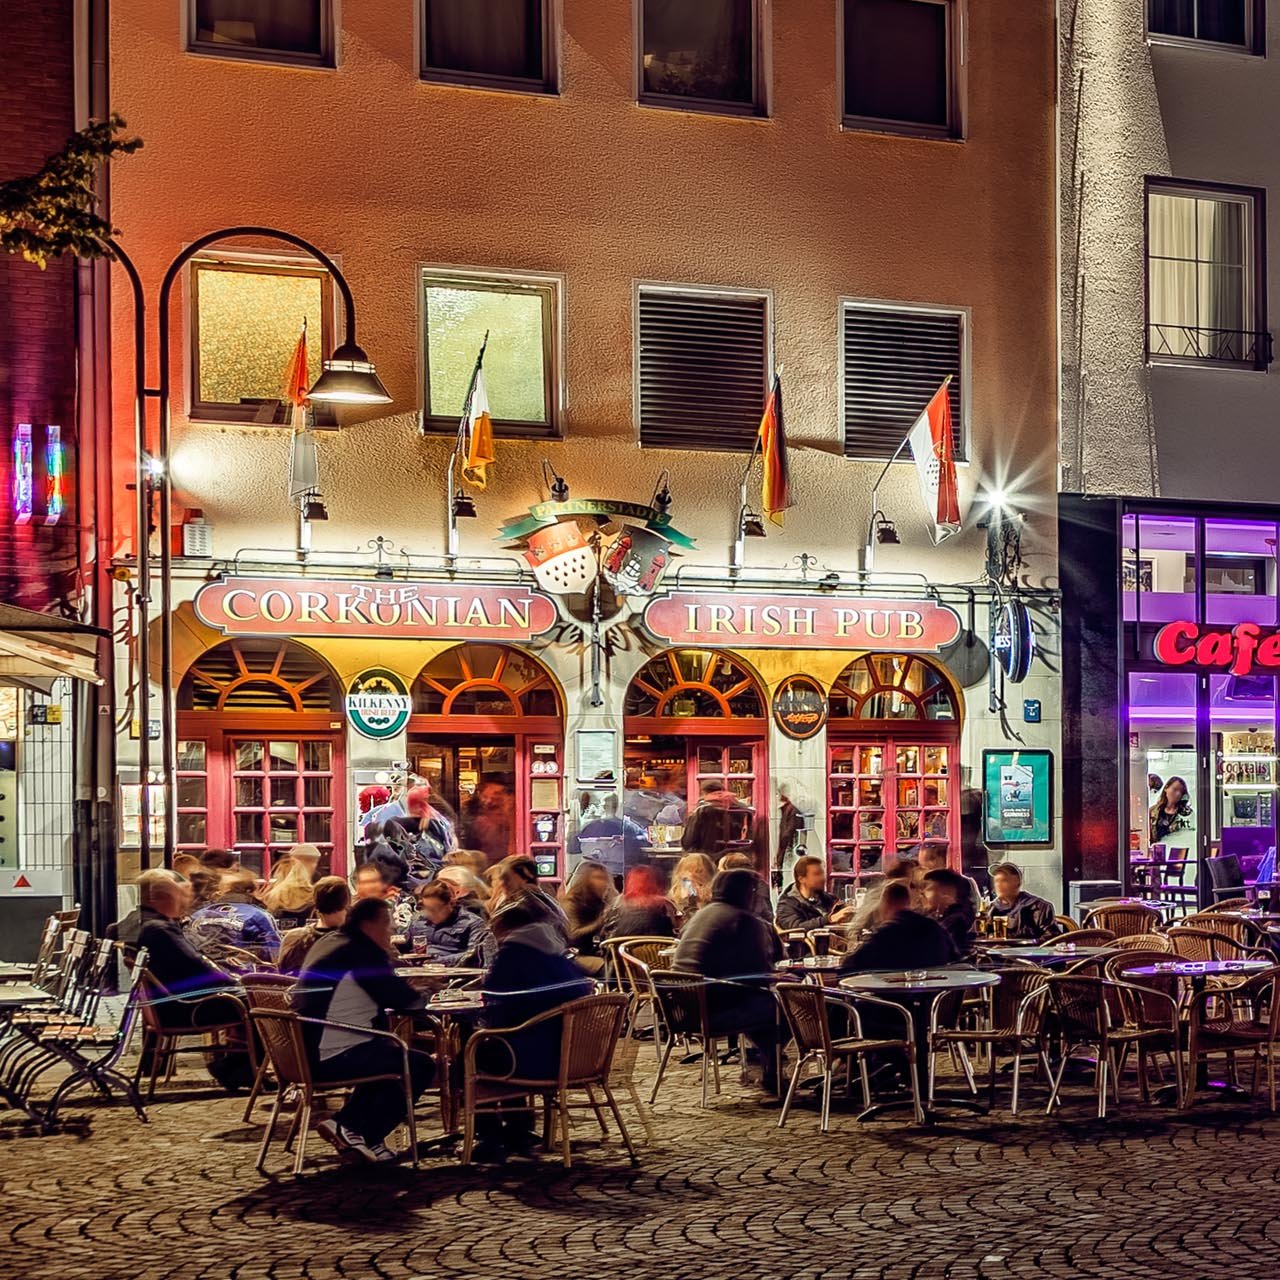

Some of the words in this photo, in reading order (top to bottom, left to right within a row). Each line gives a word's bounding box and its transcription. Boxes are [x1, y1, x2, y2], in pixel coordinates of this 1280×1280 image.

[351, 585, 418, 605] THE
[683, 603, 818, 636] IRISH
[833, 607, 925, 639] PUB
[348, 696, 408, 709] KILKENNY
[361, 708, 379, 716] IRISH
[1218, 760, 1268, 774] Cocktails
